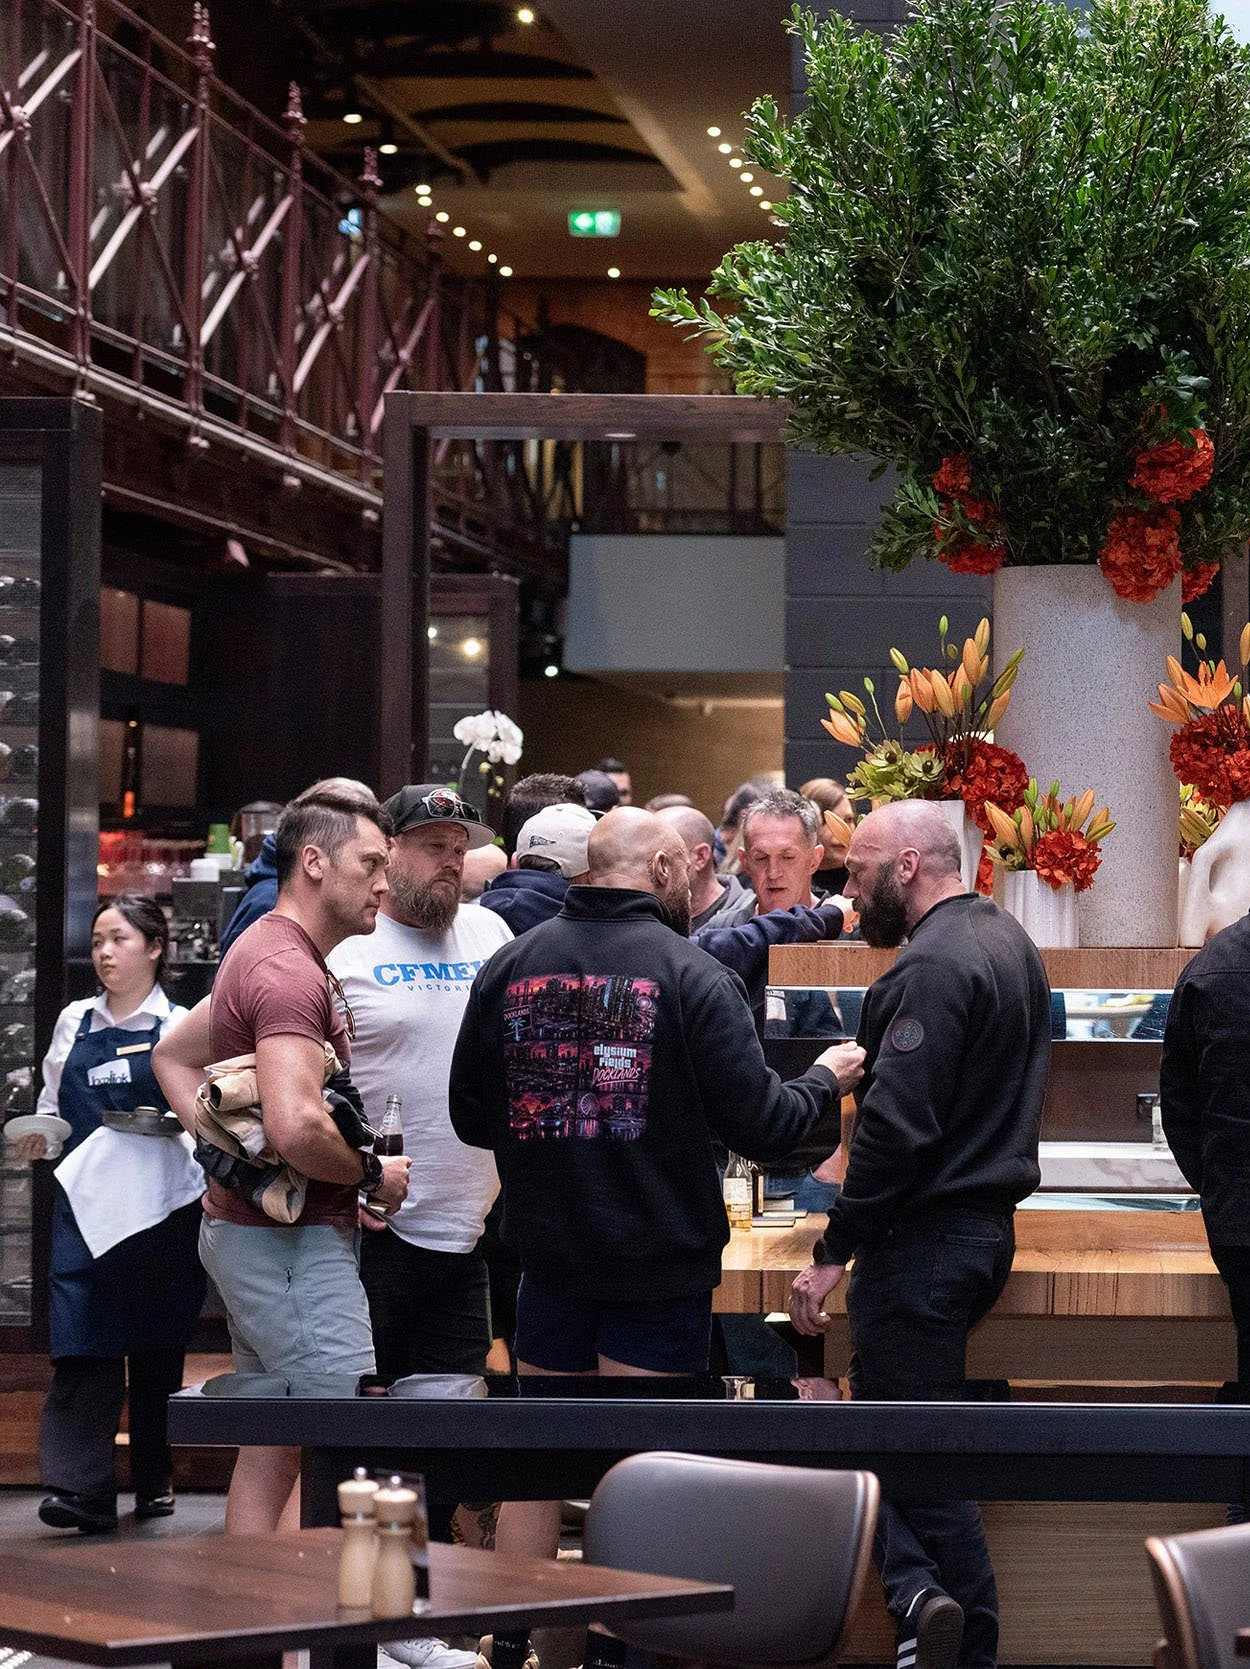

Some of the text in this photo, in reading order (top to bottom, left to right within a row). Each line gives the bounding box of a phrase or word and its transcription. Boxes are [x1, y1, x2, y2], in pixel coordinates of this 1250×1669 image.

[373, 960, 488, 986] CFME
[407, 983, 471, 992] VICTORI
[593, 1044, 637, 1058] elysium
[599, 1057, 632, 1070] fields
[592, 1067, 641, 1086] DOCKLANDS
